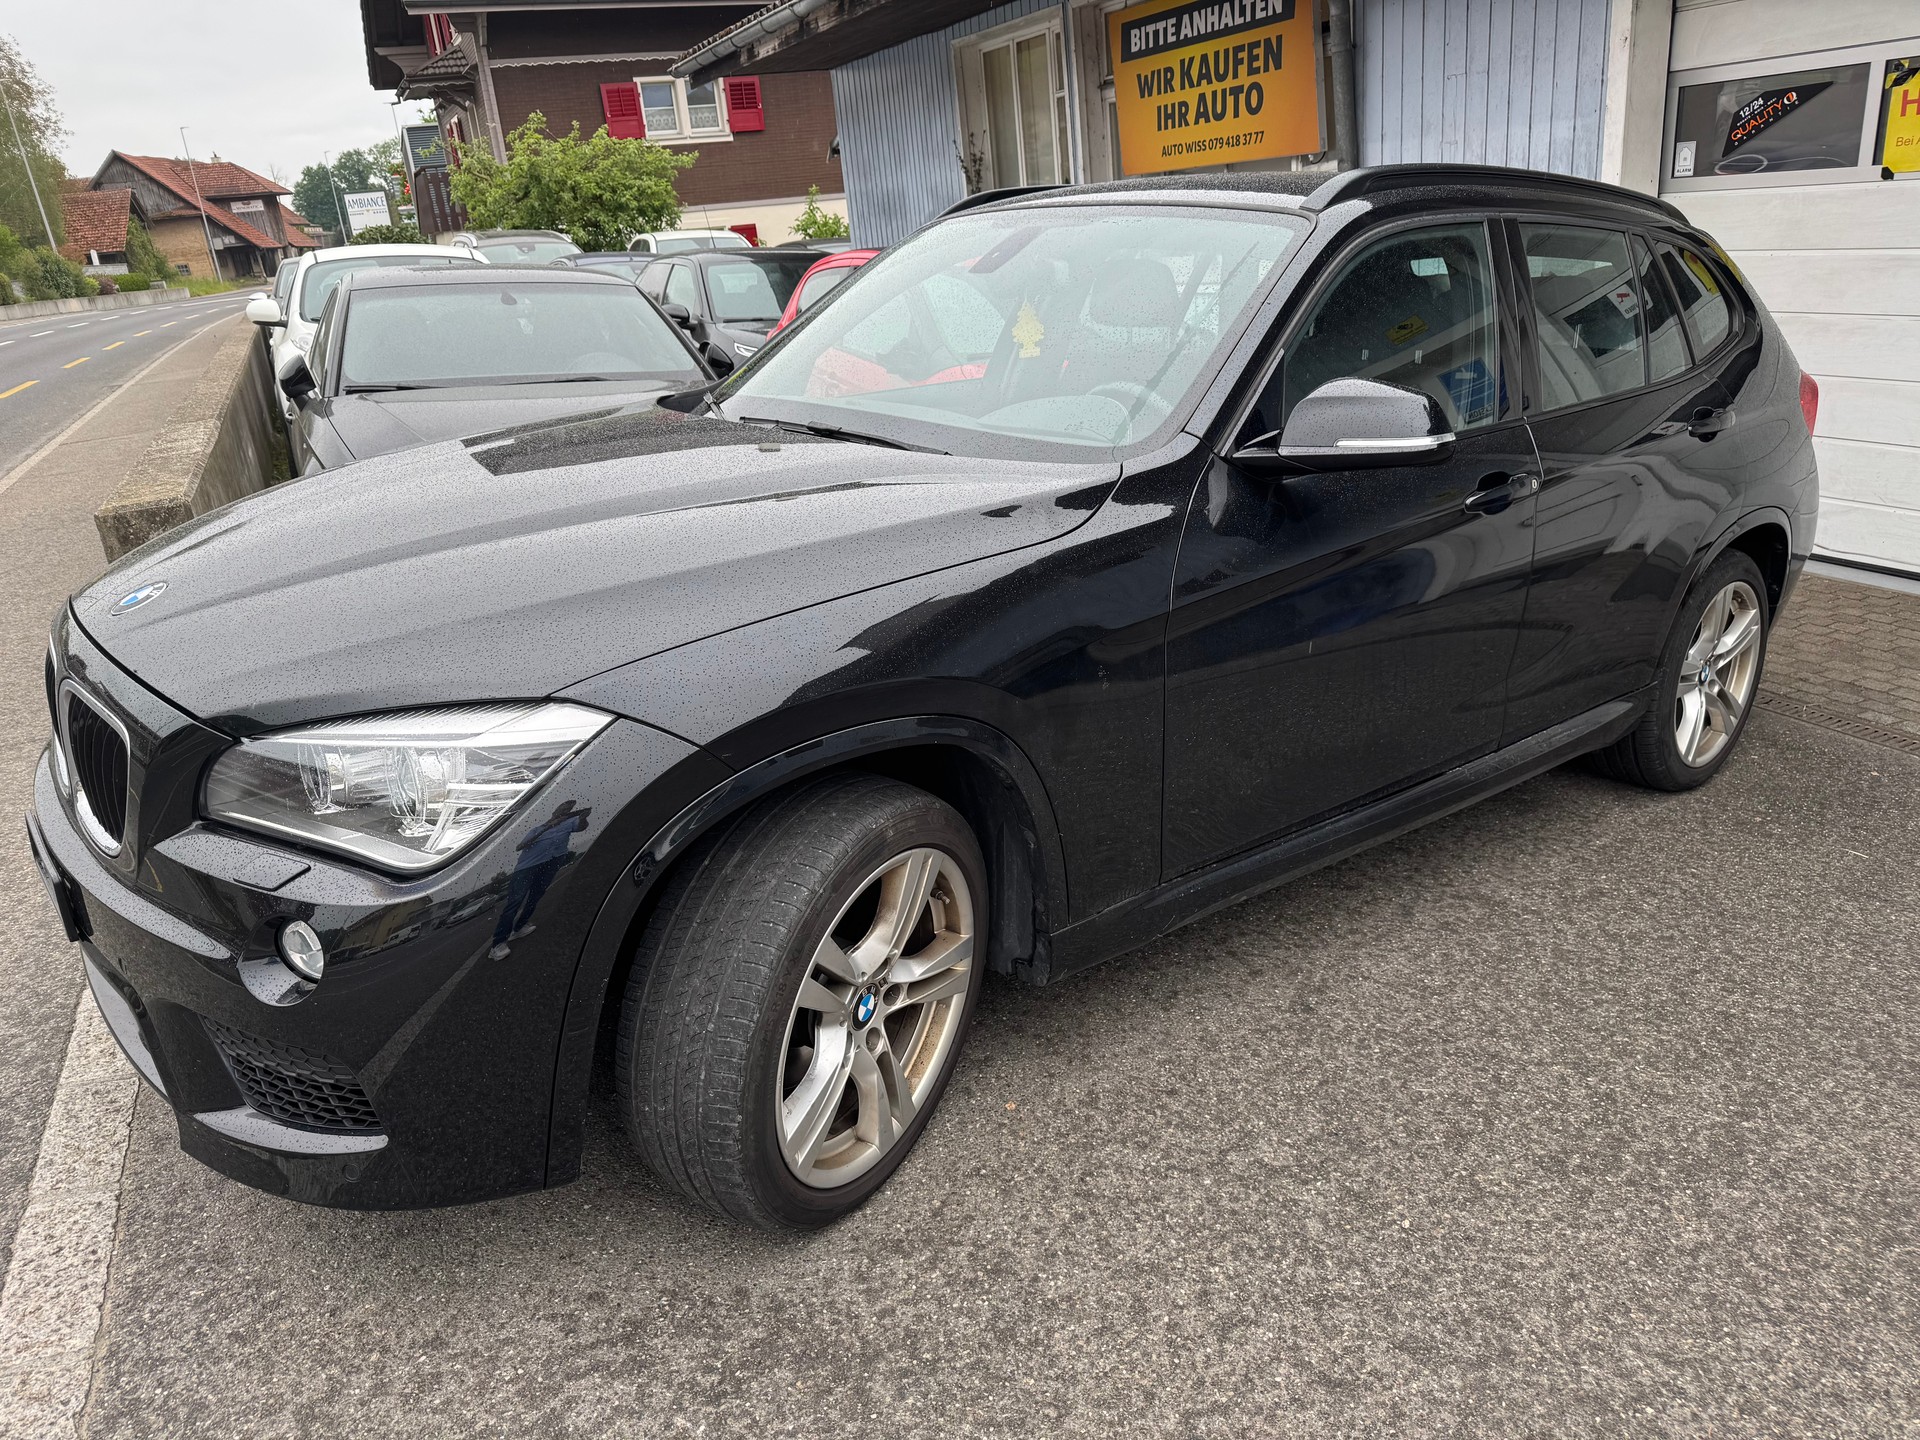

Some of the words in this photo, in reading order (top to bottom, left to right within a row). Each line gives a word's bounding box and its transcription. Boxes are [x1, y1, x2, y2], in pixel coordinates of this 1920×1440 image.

[1130, 17, 1177, 53] BITTE
[1180, 0, 1283, 40] ANHALTEN
[1136, 66, 1175, 99] WIR
[1180, 34, 1283, 90] KAUFEN
[1157, 100, 1190, 131] IHR
[1194, 81, 1264, 125] AUTO
[1731, 99, 1783, 141] QUALITY
[1739, 97, 1764, 118] 12/24
[1161, 143, 1184, 157] AUTO
[1185, 139, 1207, 154] WISS
[1208, 137, 1224, 150] 079
[1225, 134, 1241, 148] 418
[1242, 132, 1252, 146] 37
[1254, 130, 1265, 144] 77
[1896, 136, 1915, 147] Bei
[347, 196, 386, 209] AMBIANCE
